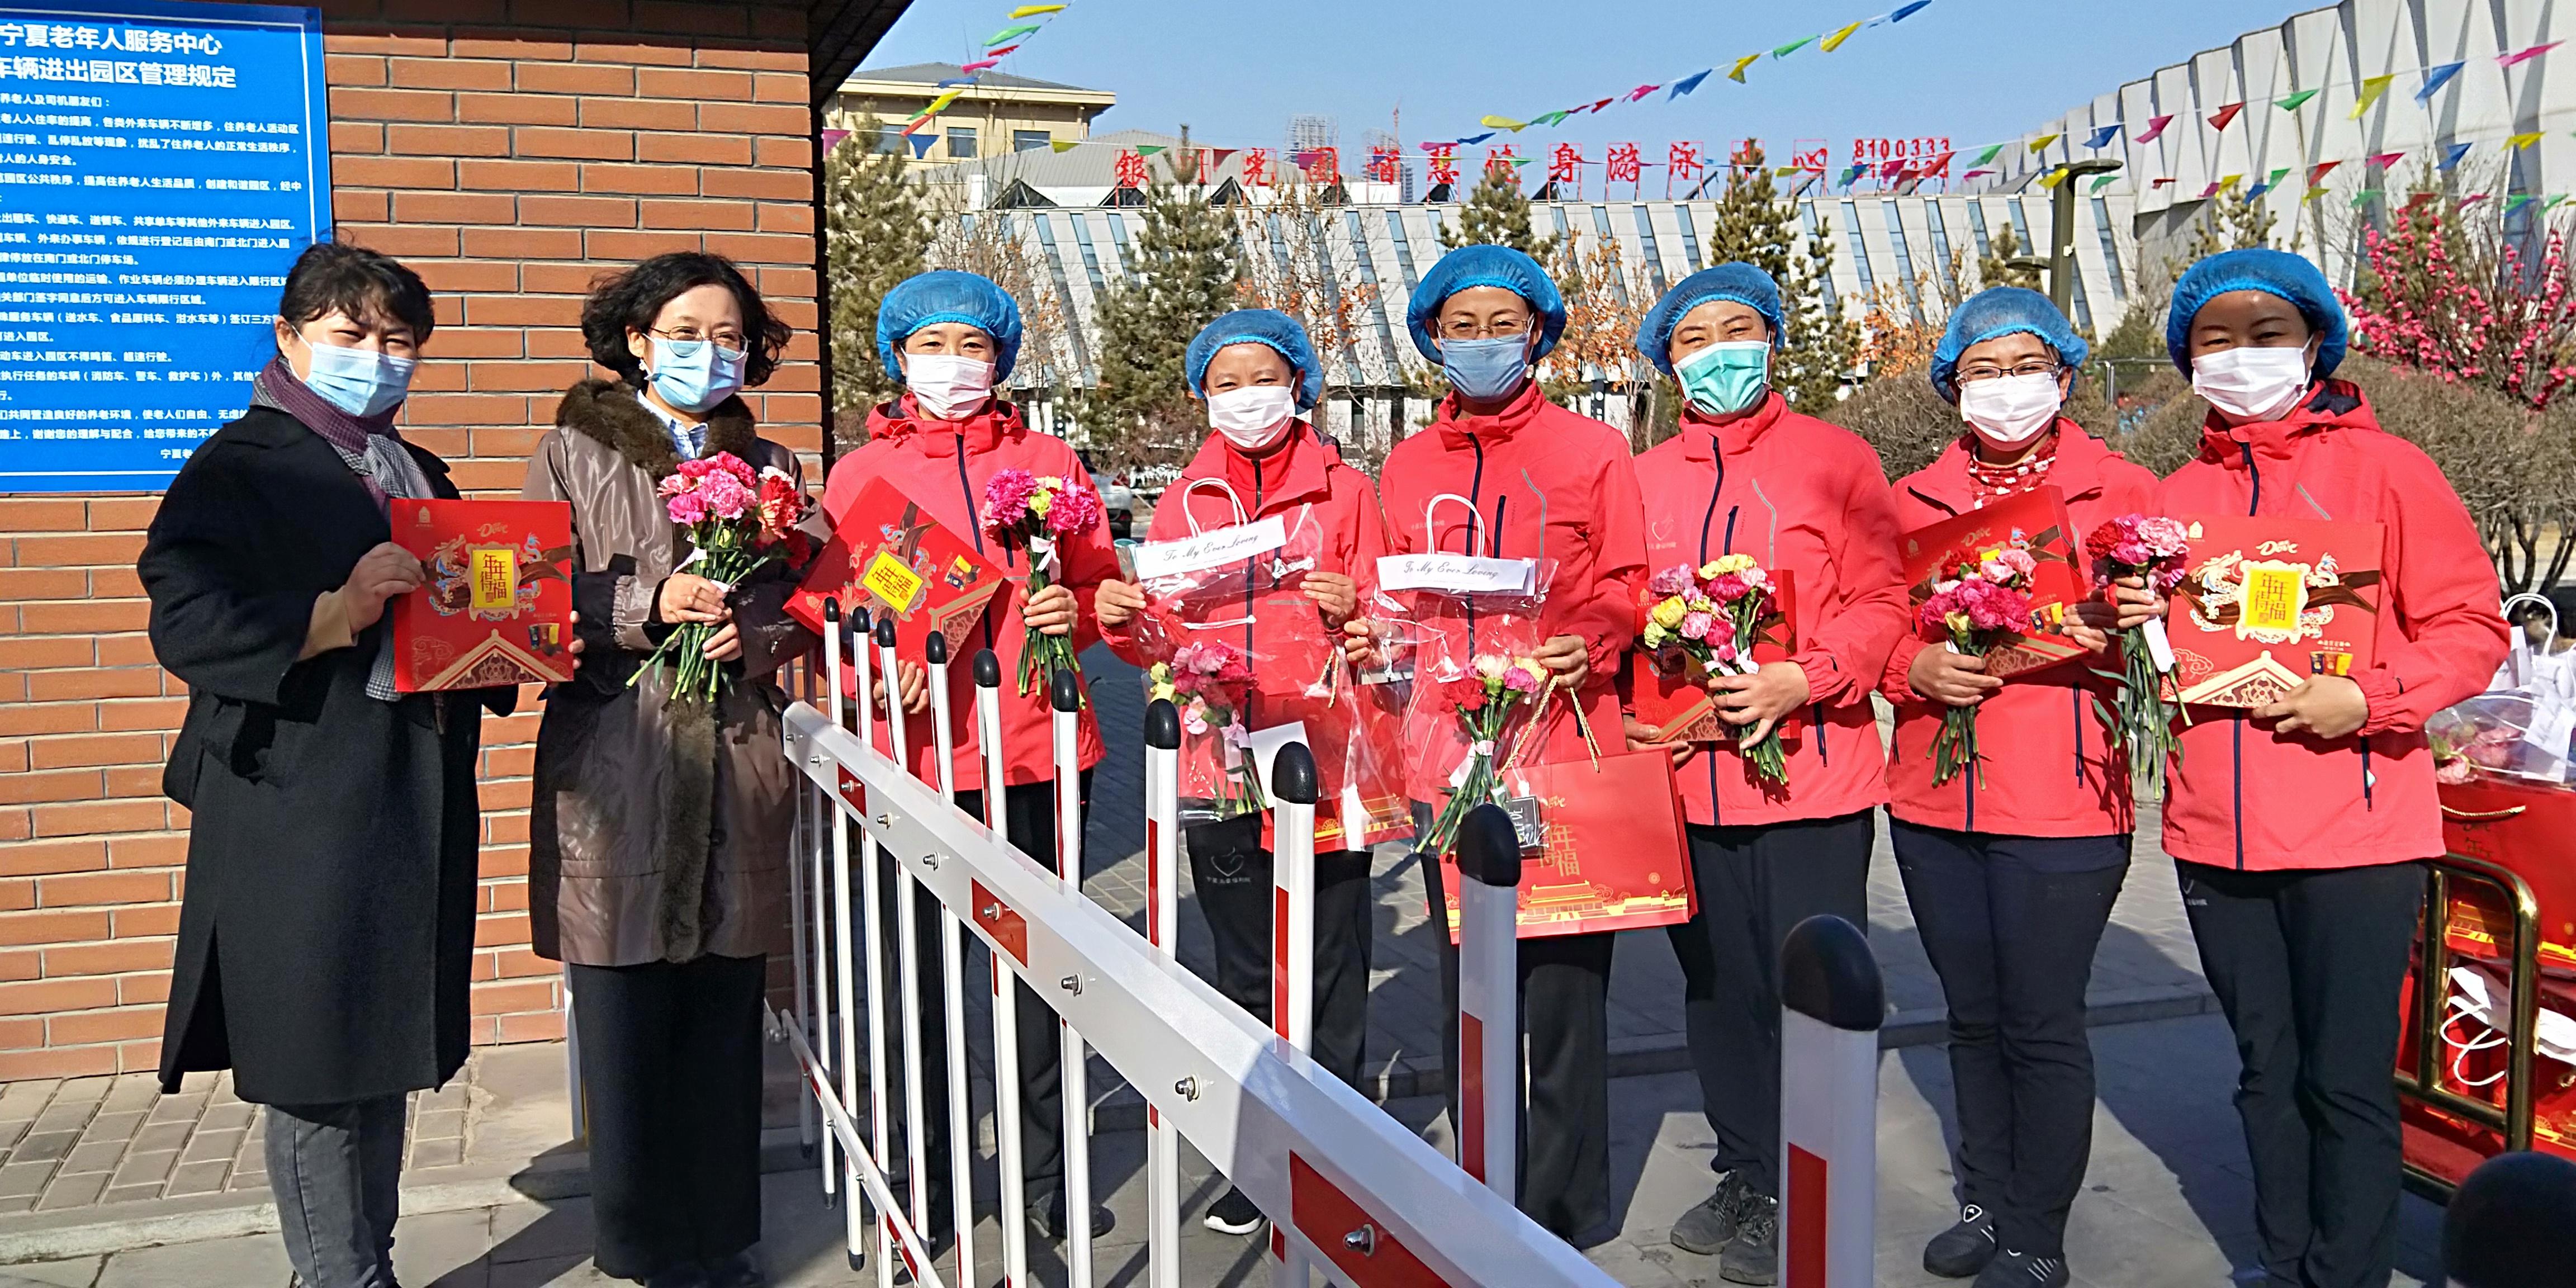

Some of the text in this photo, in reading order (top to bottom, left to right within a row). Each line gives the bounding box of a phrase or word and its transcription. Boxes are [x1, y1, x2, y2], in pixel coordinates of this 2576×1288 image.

[0, 22, 222, 55] 宁夏老年人服务中心
[1182, 546, 1200, 559] My
[1417, 561, 1433, 575] My
